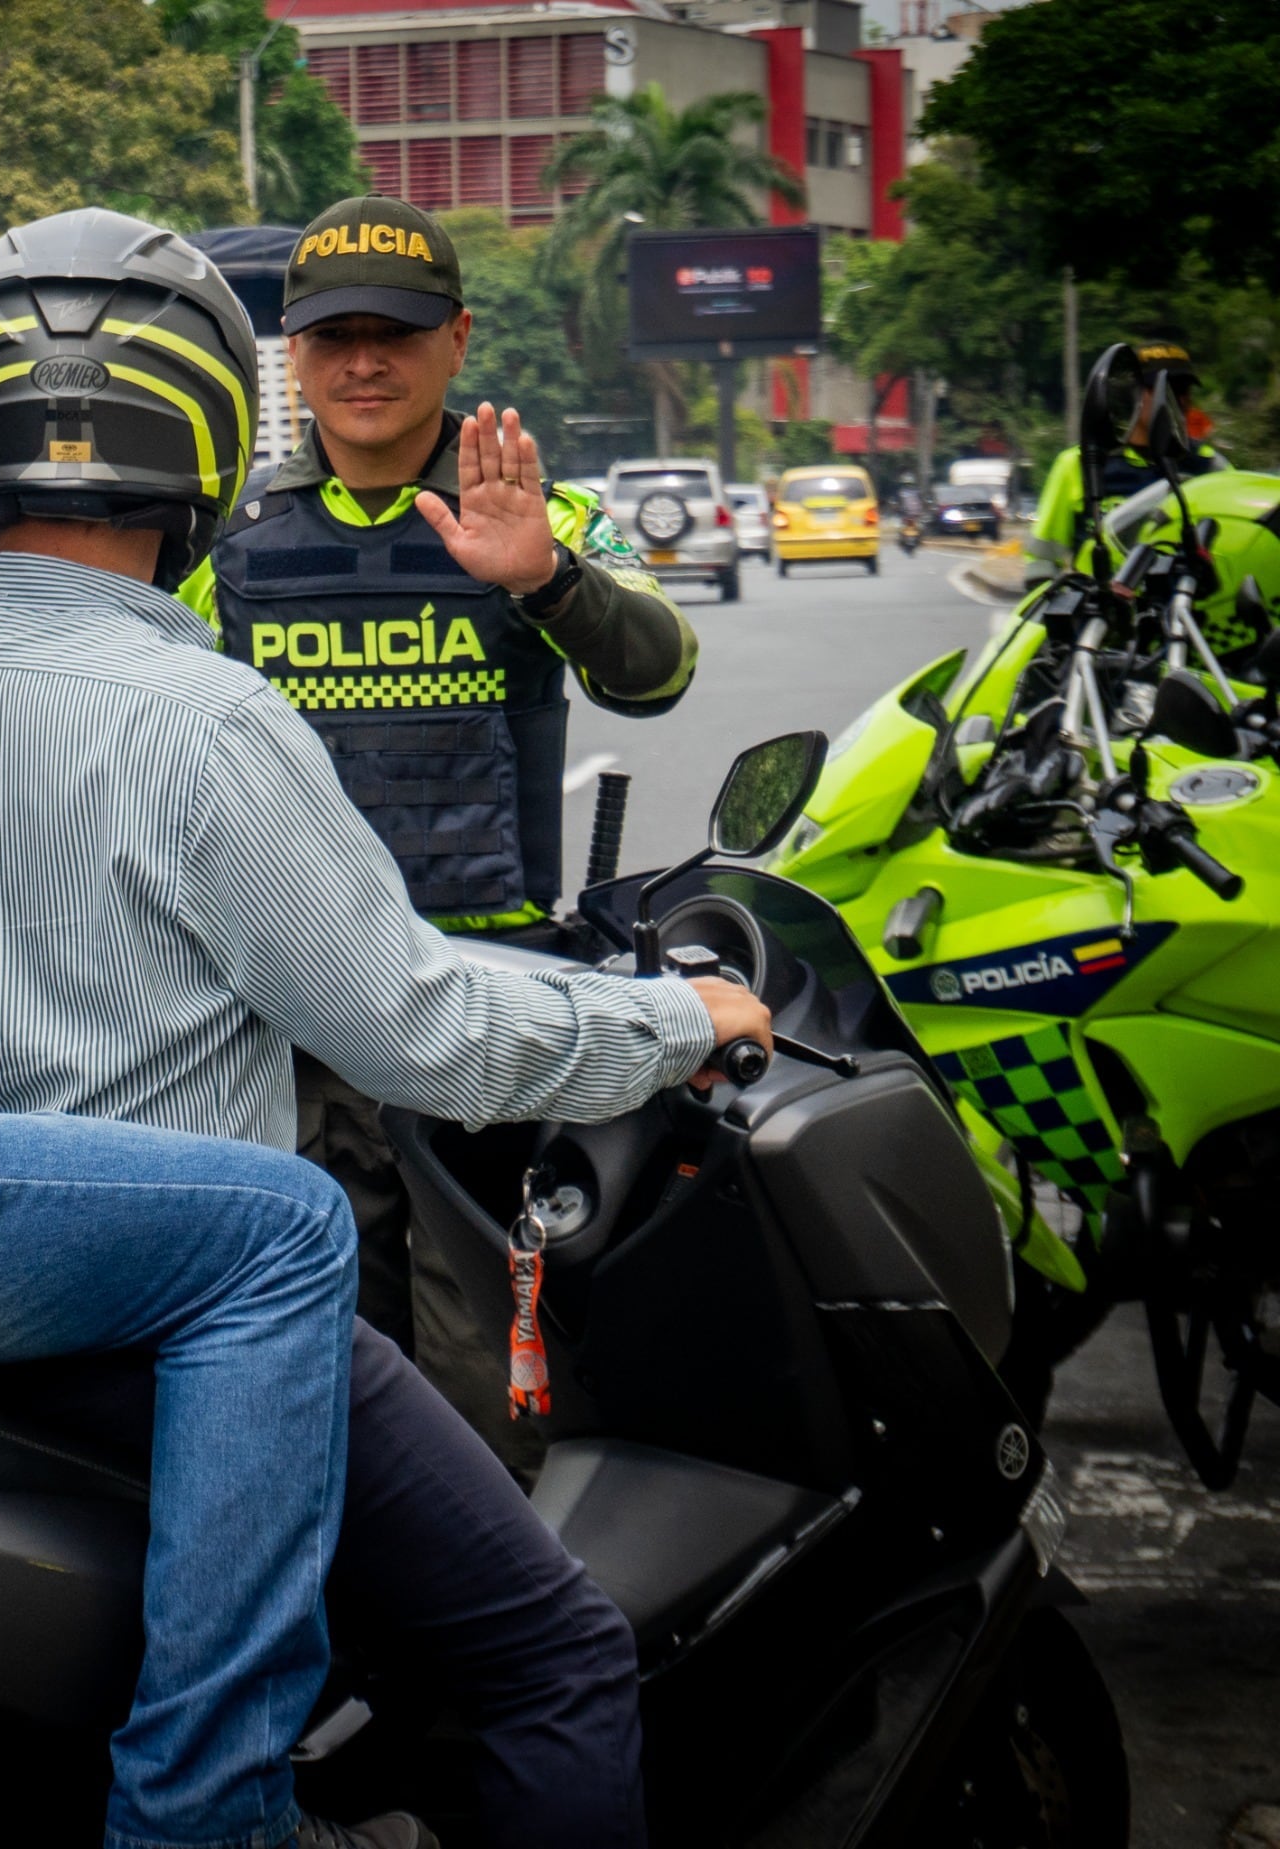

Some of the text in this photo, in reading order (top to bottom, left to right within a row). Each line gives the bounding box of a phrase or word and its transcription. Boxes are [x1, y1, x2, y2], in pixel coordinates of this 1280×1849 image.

[297, 223, 433, 265] POLICIA
[37, 362, 107, 392] PREMIER
[252, 602, 487, 668] POLICÍA
[960, 952, 1075, 995] POLICÍA
